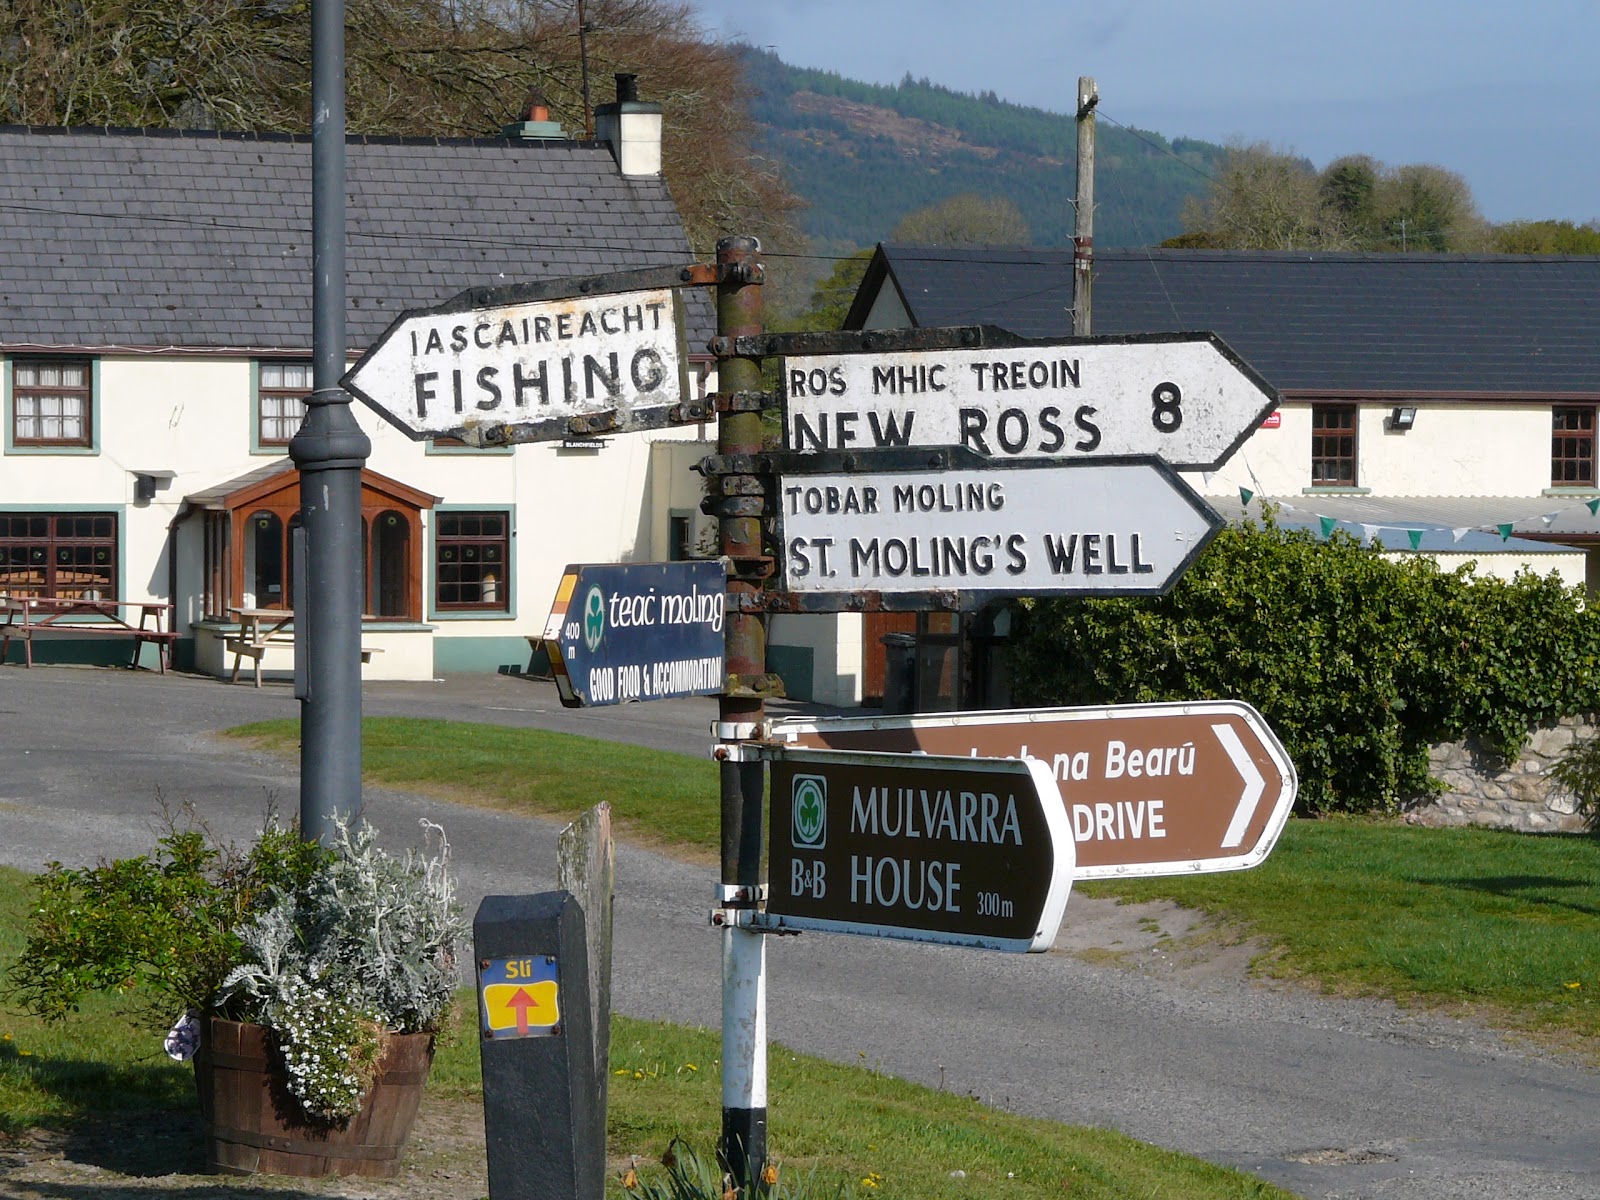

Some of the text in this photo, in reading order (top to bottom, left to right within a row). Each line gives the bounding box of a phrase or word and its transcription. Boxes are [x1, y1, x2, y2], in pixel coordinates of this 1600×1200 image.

[411, 303, 666, 357] IASCAIREACHT
[415, 348, 664, 418] FISHING
[790, 359, 1081, 398] ROS MHIC TREOIN
[959, 405, 1102, 455] ROSS
[1151, 381, 1182, 434] 8
[786, 482, 1006, 516] TOBAR MOLING
[789, 533, 1155, 578] ST. MOLING'S WELL
[661, 583, 724, 632] moling
[565, 622, 580, 640] 400
[568, 646, 575, 659] m
[590, 656, 722, 702] GOOD FOOD & ACCOMMODATION
[1053, 751, 1089, 781] na
[1105, 740, 1195, 778] Bearú
[850, 785, 1023, 846] MULVARRA
[1073, 799, 1166, 842] DRIVE
[791, 858, 826, 899] B&B
[850, 855, 961, 913] HOUSE
[505, 959, 532, 979] Slí
